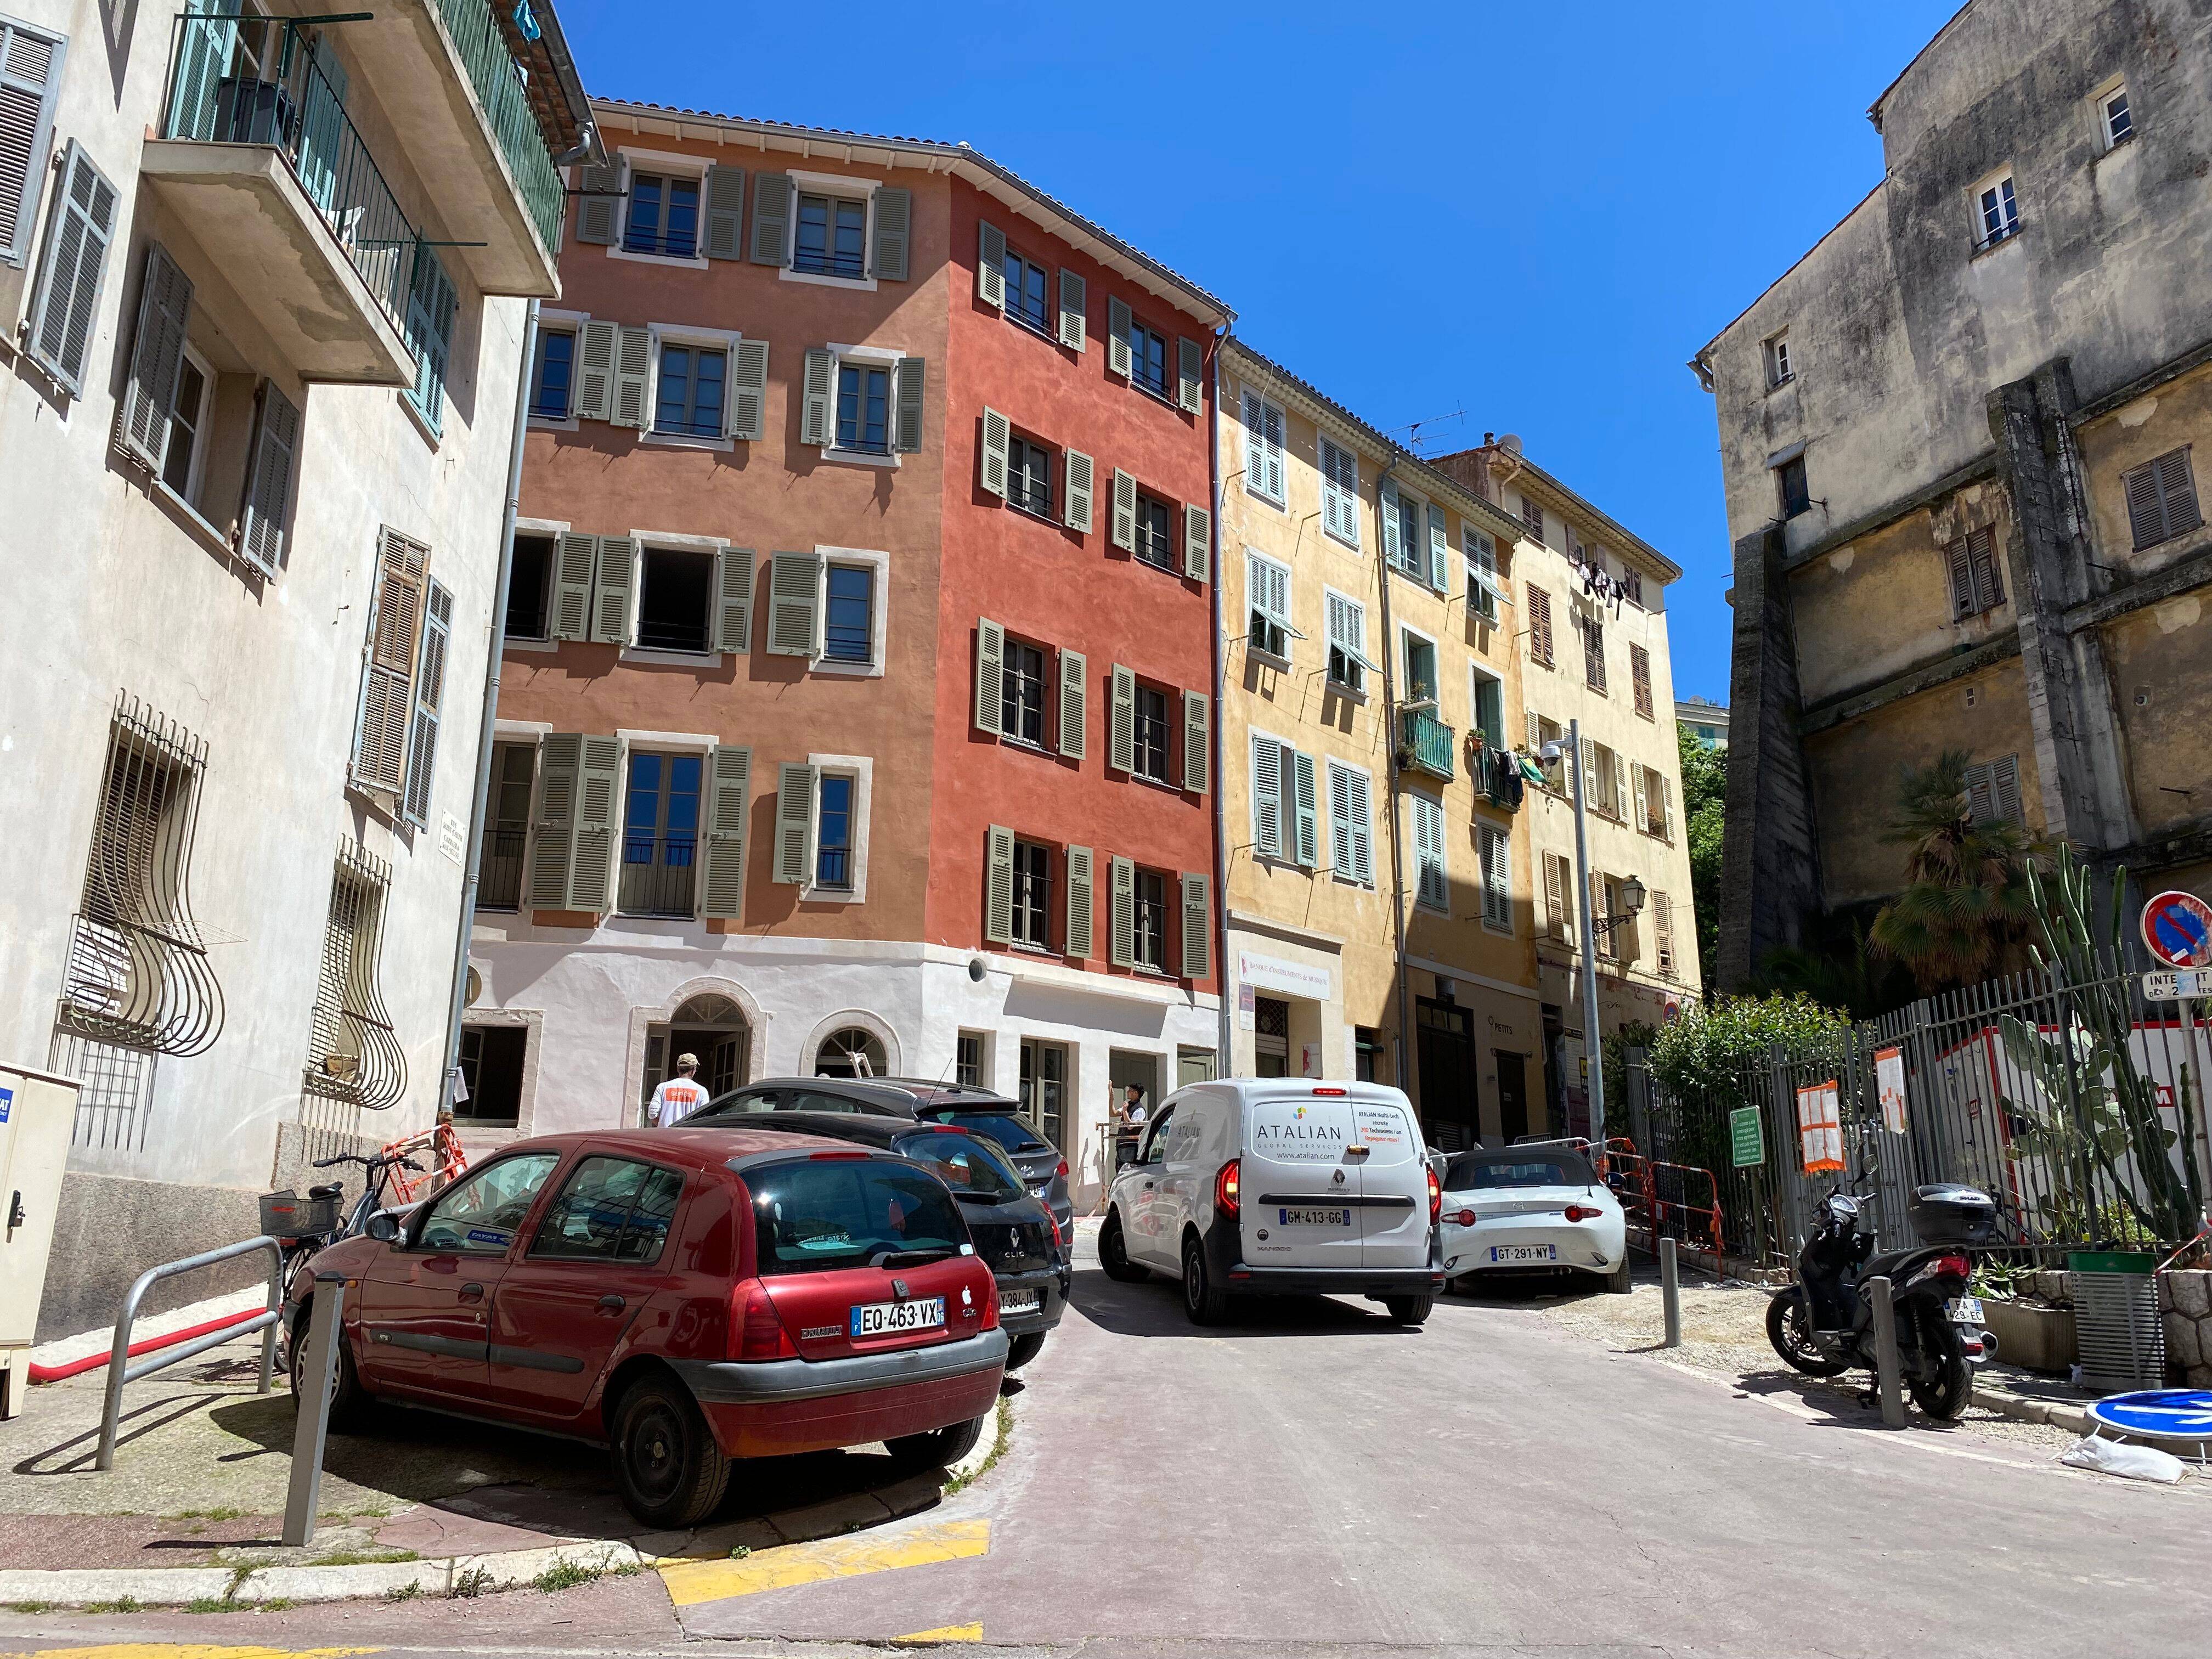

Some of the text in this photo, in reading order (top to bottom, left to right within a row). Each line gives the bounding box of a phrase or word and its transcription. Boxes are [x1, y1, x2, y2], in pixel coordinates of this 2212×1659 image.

[1249, 962, 1268, 972] BANQUE
[1308, 975, 1327, 986] MUSIQUE
[1494, 1022, 1513, 1035] PETITS
[1257, 1125, 1341, 1140] ATALIAN
[1288, 1211, 1341, 1223] GM-413-GG
[1498, 1247, 1548, 1260] GT-291-NY
[1001, 1291, 1034, 1309] Y-384-JX
[863, 1302, 936, 1331] EQ-463-VX
[937, 1312, 944, 1323] 06
